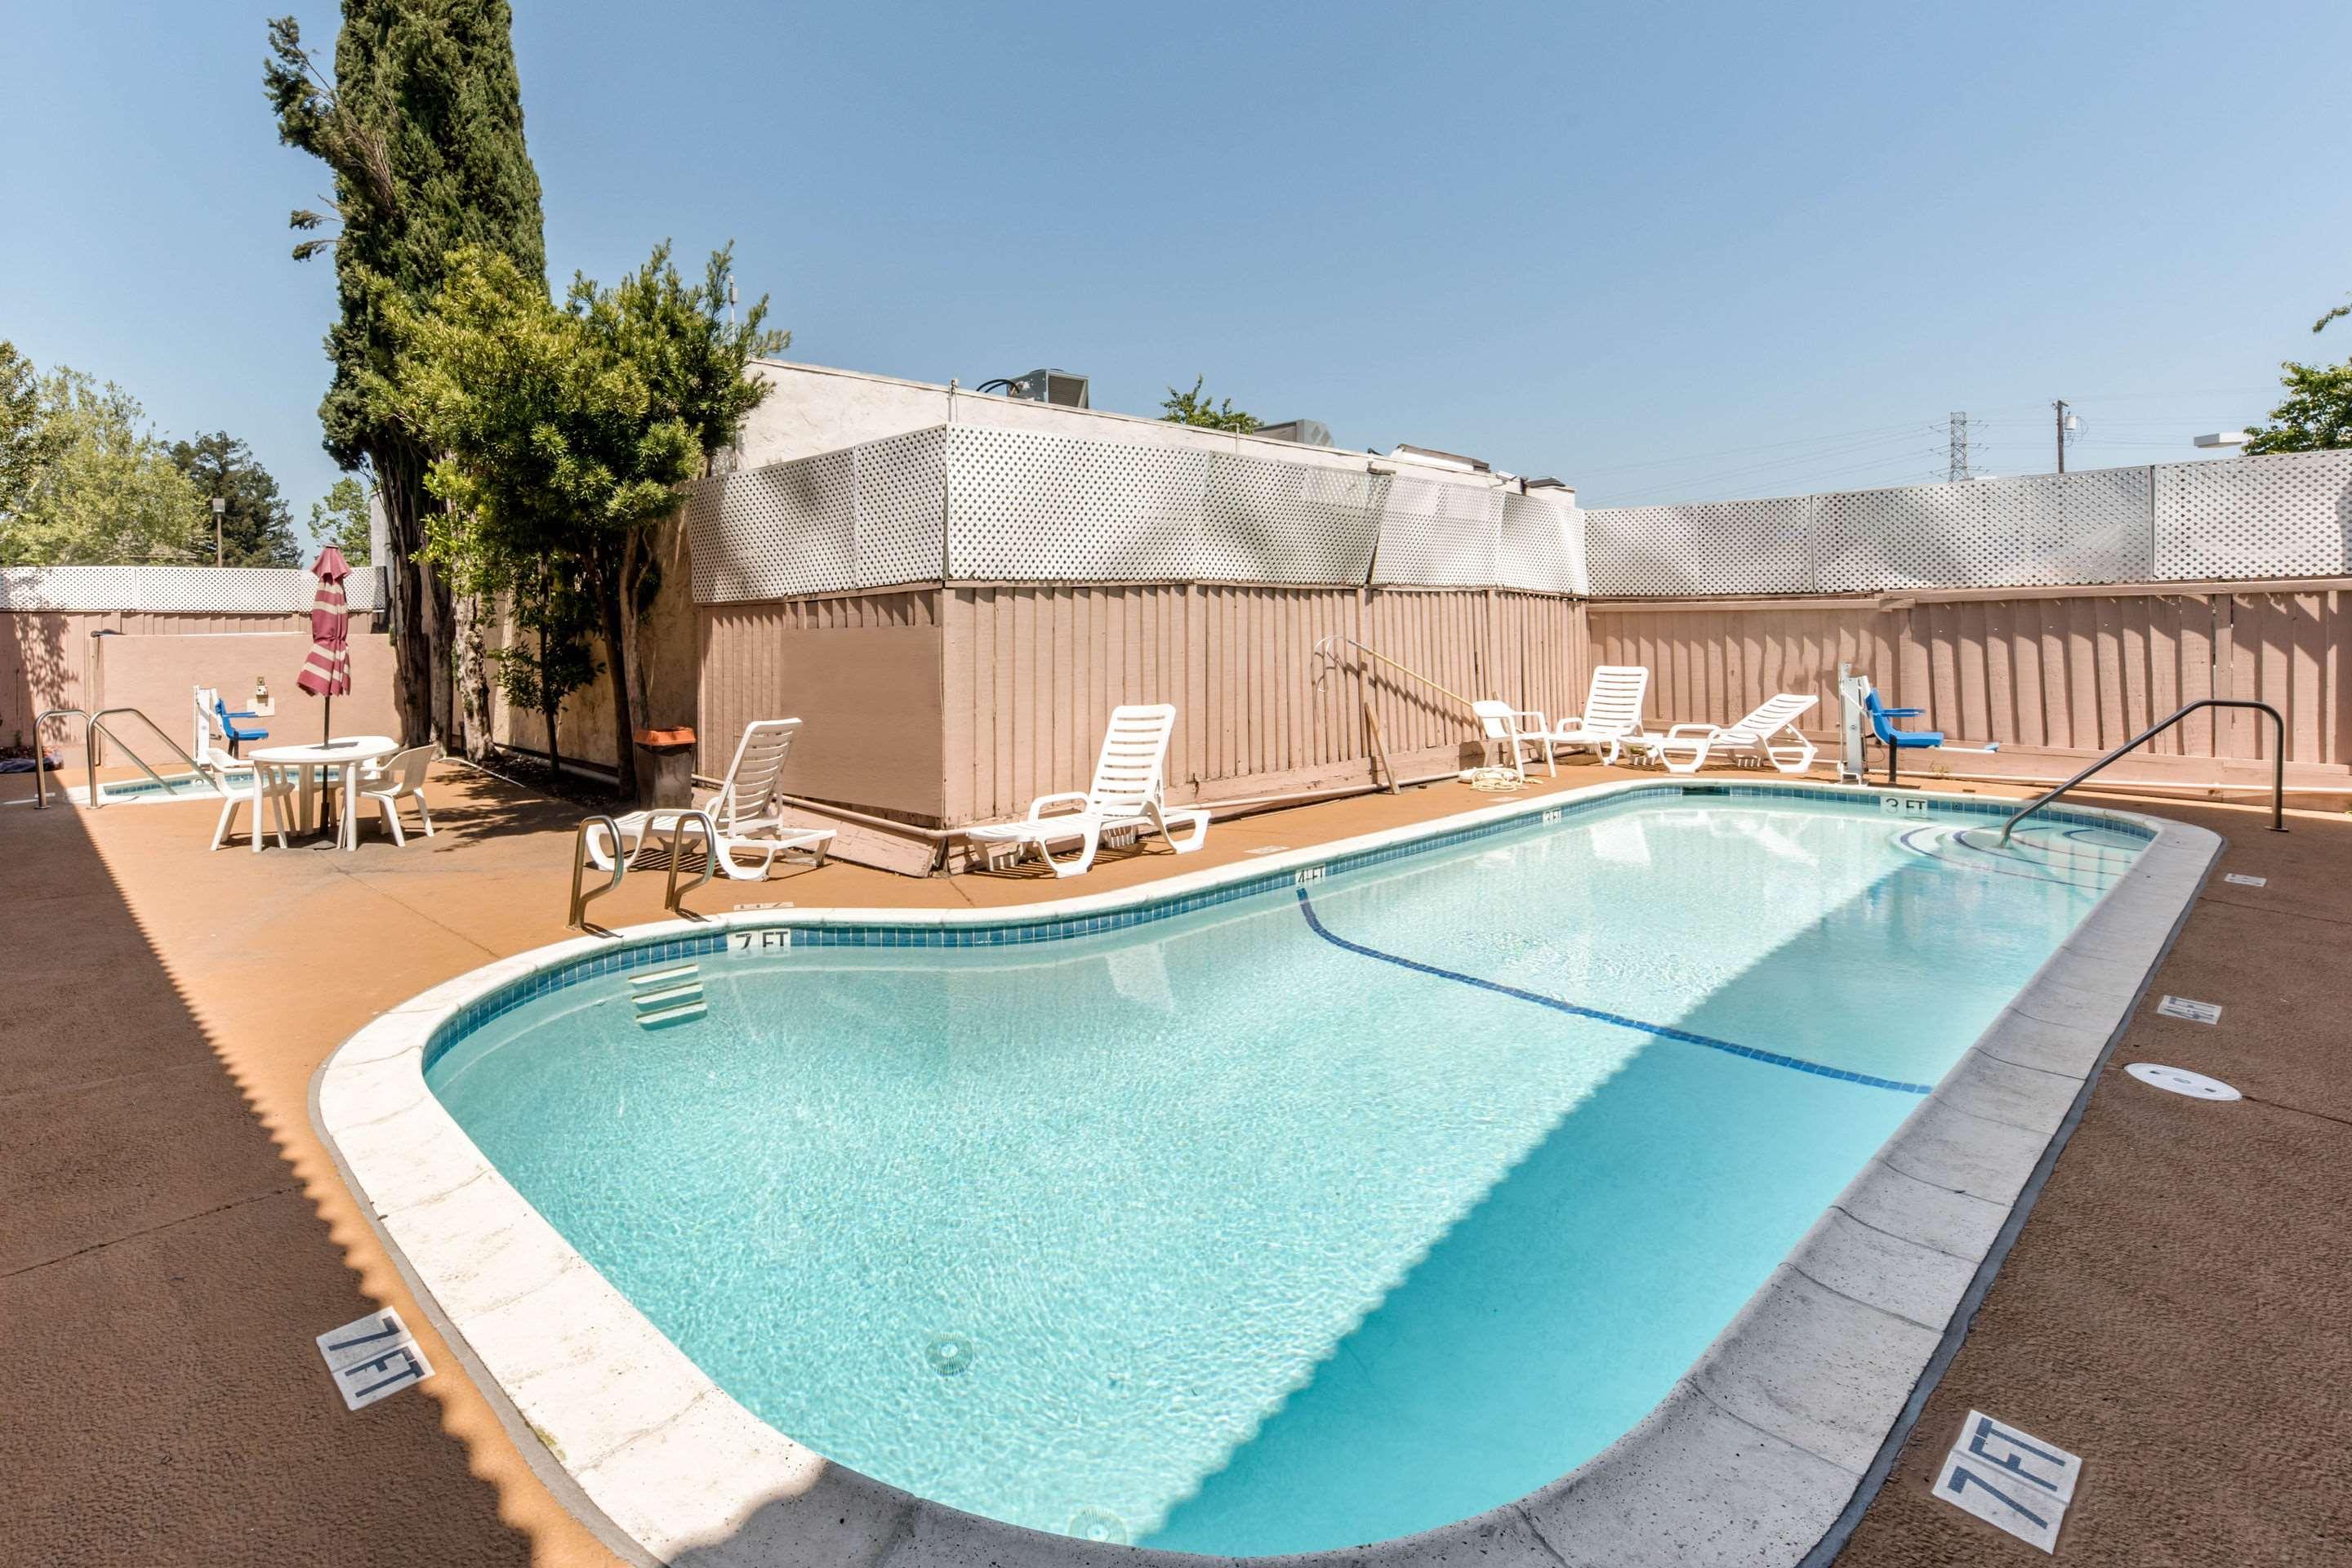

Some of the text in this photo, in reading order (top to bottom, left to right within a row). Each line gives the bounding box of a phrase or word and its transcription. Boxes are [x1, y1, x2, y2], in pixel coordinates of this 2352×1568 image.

[1906, 800, 1926, 810] FT
[735, 931, 789, 950] 7 FT
[328, 1316, 425, 1398] 7 FT
[1947, 1417, 2066, 1530] 7 FT
